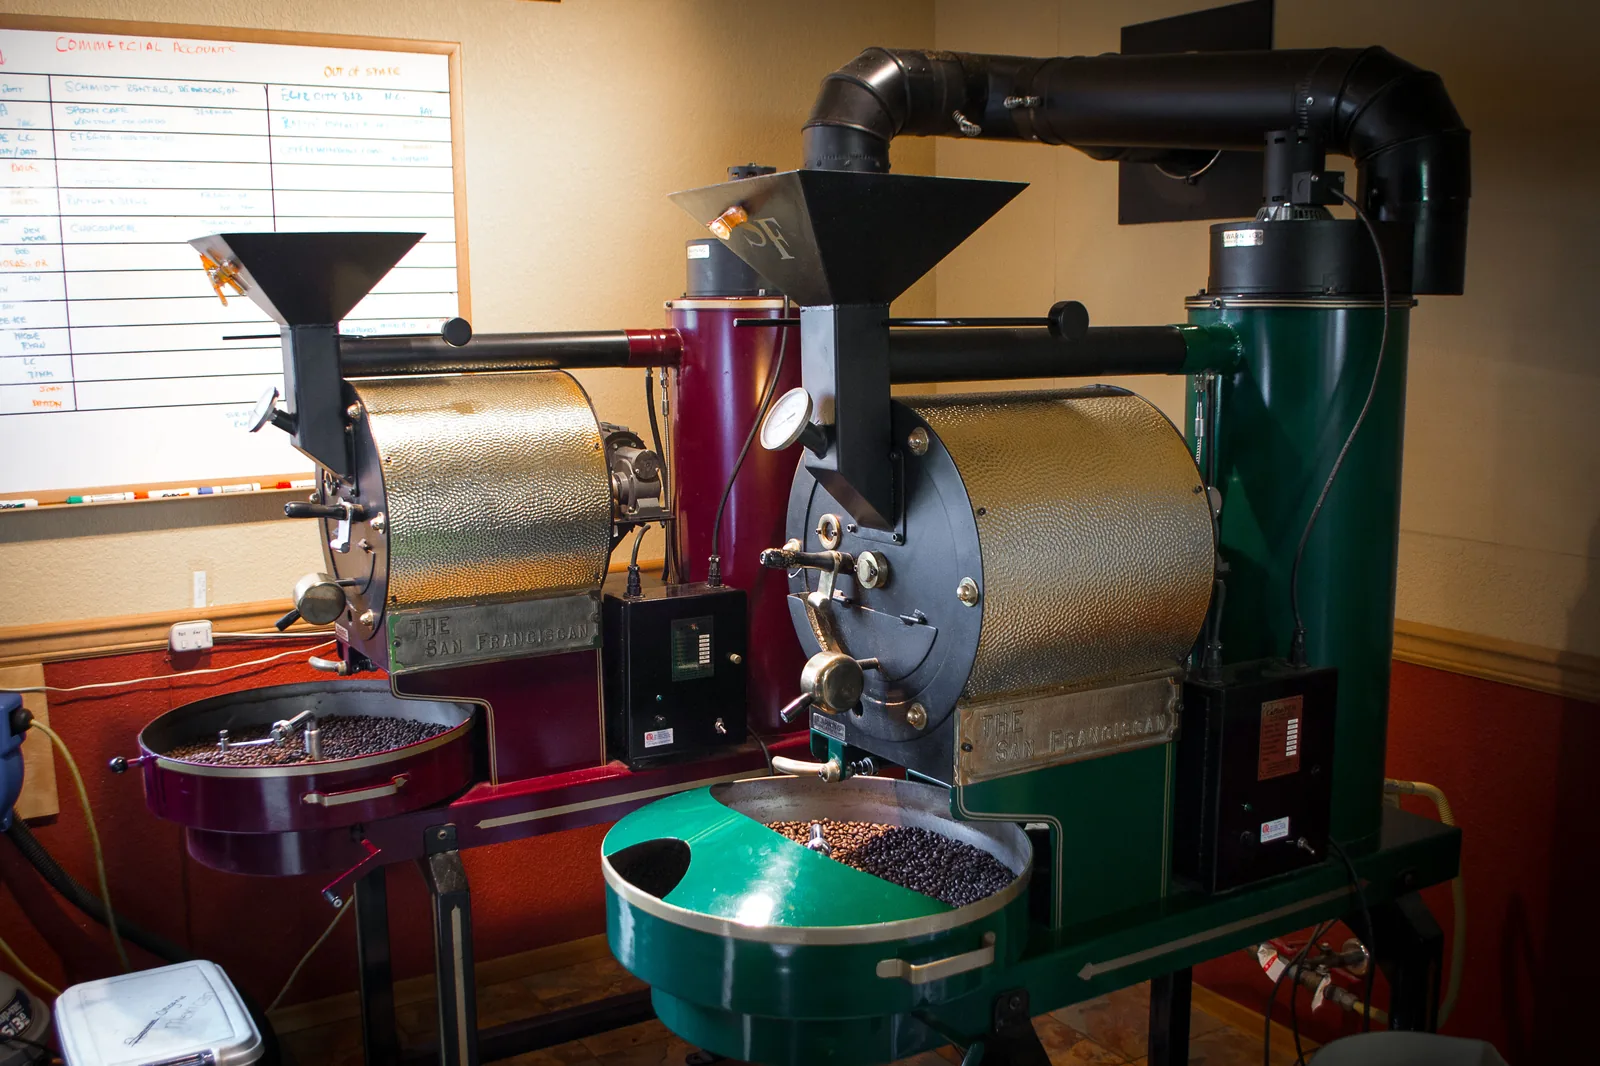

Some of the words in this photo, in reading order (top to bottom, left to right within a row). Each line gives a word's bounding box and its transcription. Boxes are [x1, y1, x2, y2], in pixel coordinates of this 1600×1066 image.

[324, 65, 344, 78] OUT
[409, 616, 450, 638] THE
[425, 639, 463, 658] SAN
[475, 624, 589, 651] FRANCISCAN
[980, 709, 1024, 738] THE
[995, 739, 1035, 763] SAN
[1050, 713, 1167, 753] FRANCISCAN
